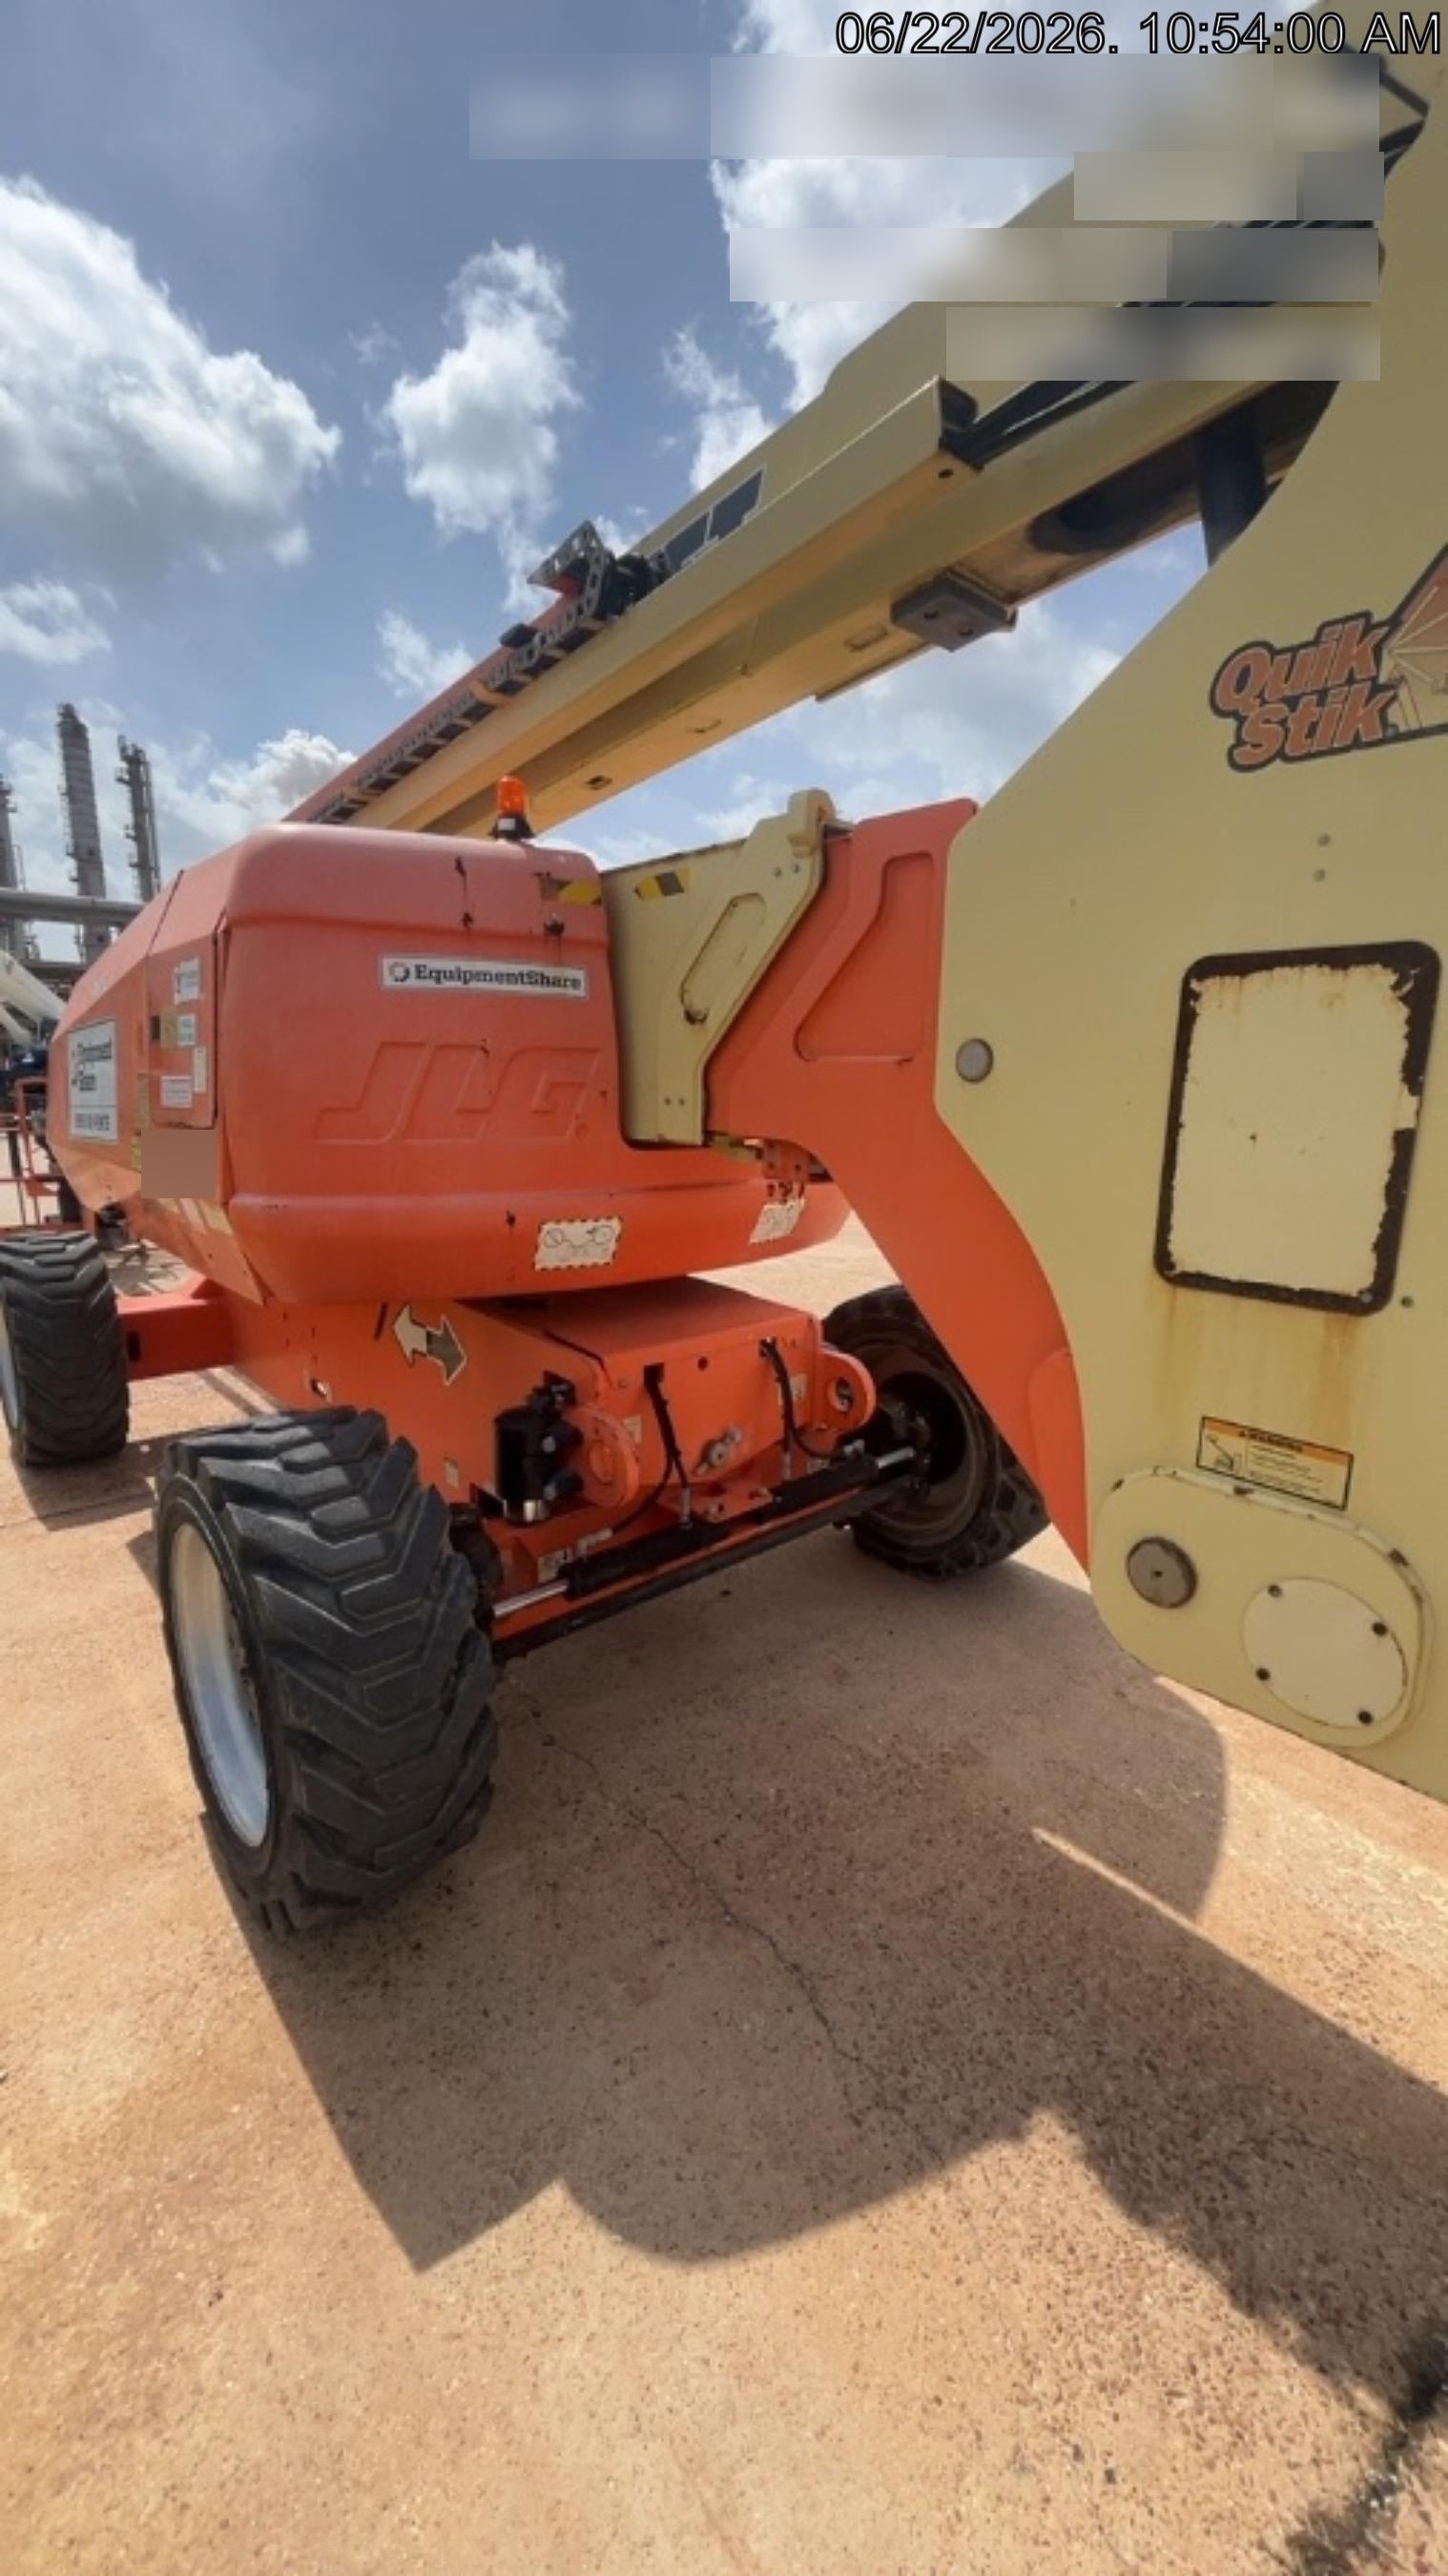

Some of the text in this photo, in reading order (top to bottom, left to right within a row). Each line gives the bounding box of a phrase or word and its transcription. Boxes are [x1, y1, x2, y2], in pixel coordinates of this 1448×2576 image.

[1215, 617, 1390, 716] Quik
[1232, 683, 1396, 766] Stik
[414, 964, 582, 991] EquipmentShare
[313, 1041, 602, 1145] JLG
